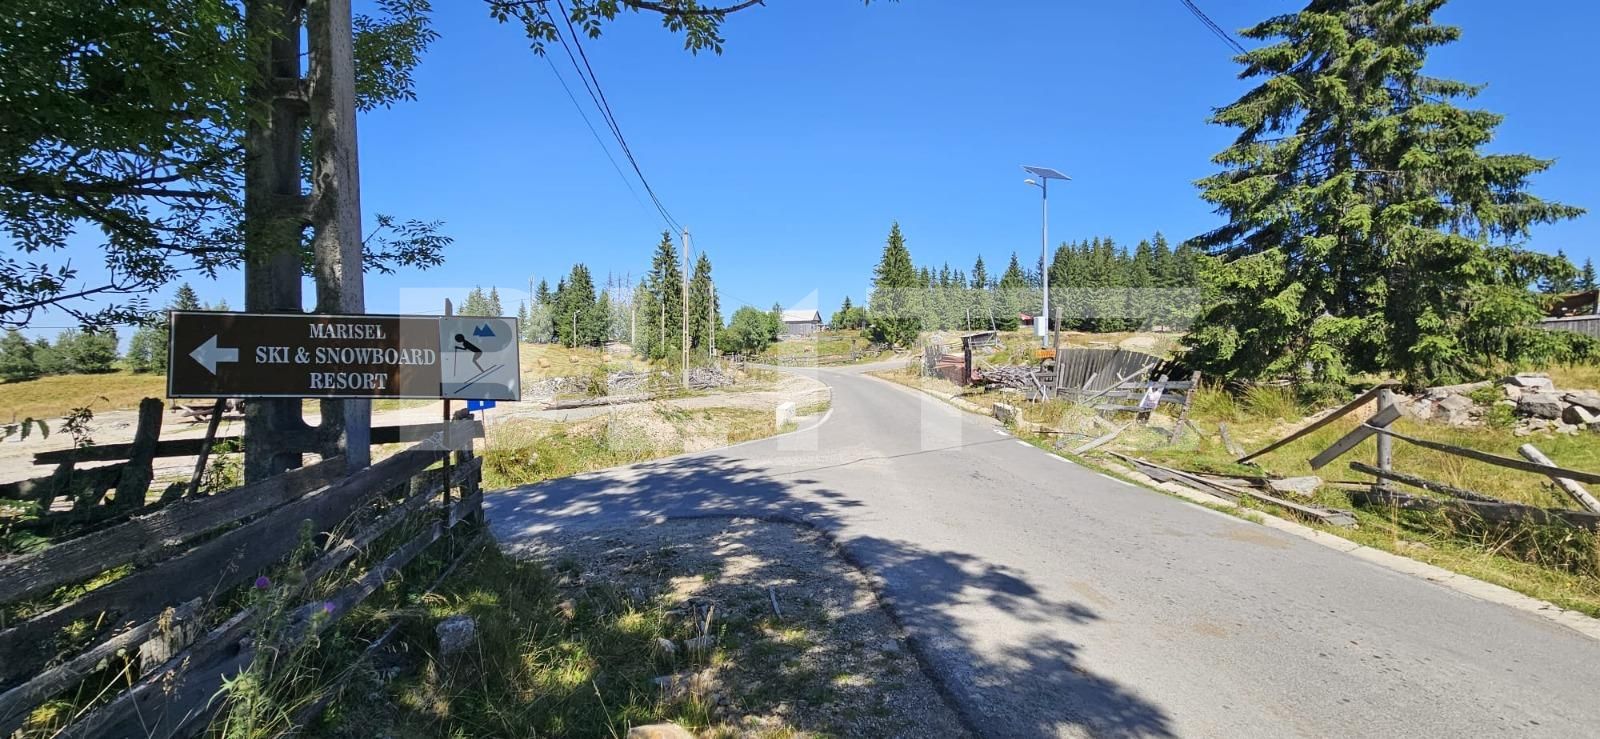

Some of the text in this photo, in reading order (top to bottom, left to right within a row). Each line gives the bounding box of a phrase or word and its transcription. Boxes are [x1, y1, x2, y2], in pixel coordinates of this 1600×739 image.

[309, 323, 386, 339] MARISEL
[255, 346, 436, 366] SKI & SNOWBOARD
[309, 372, 388, 390] RESORT
